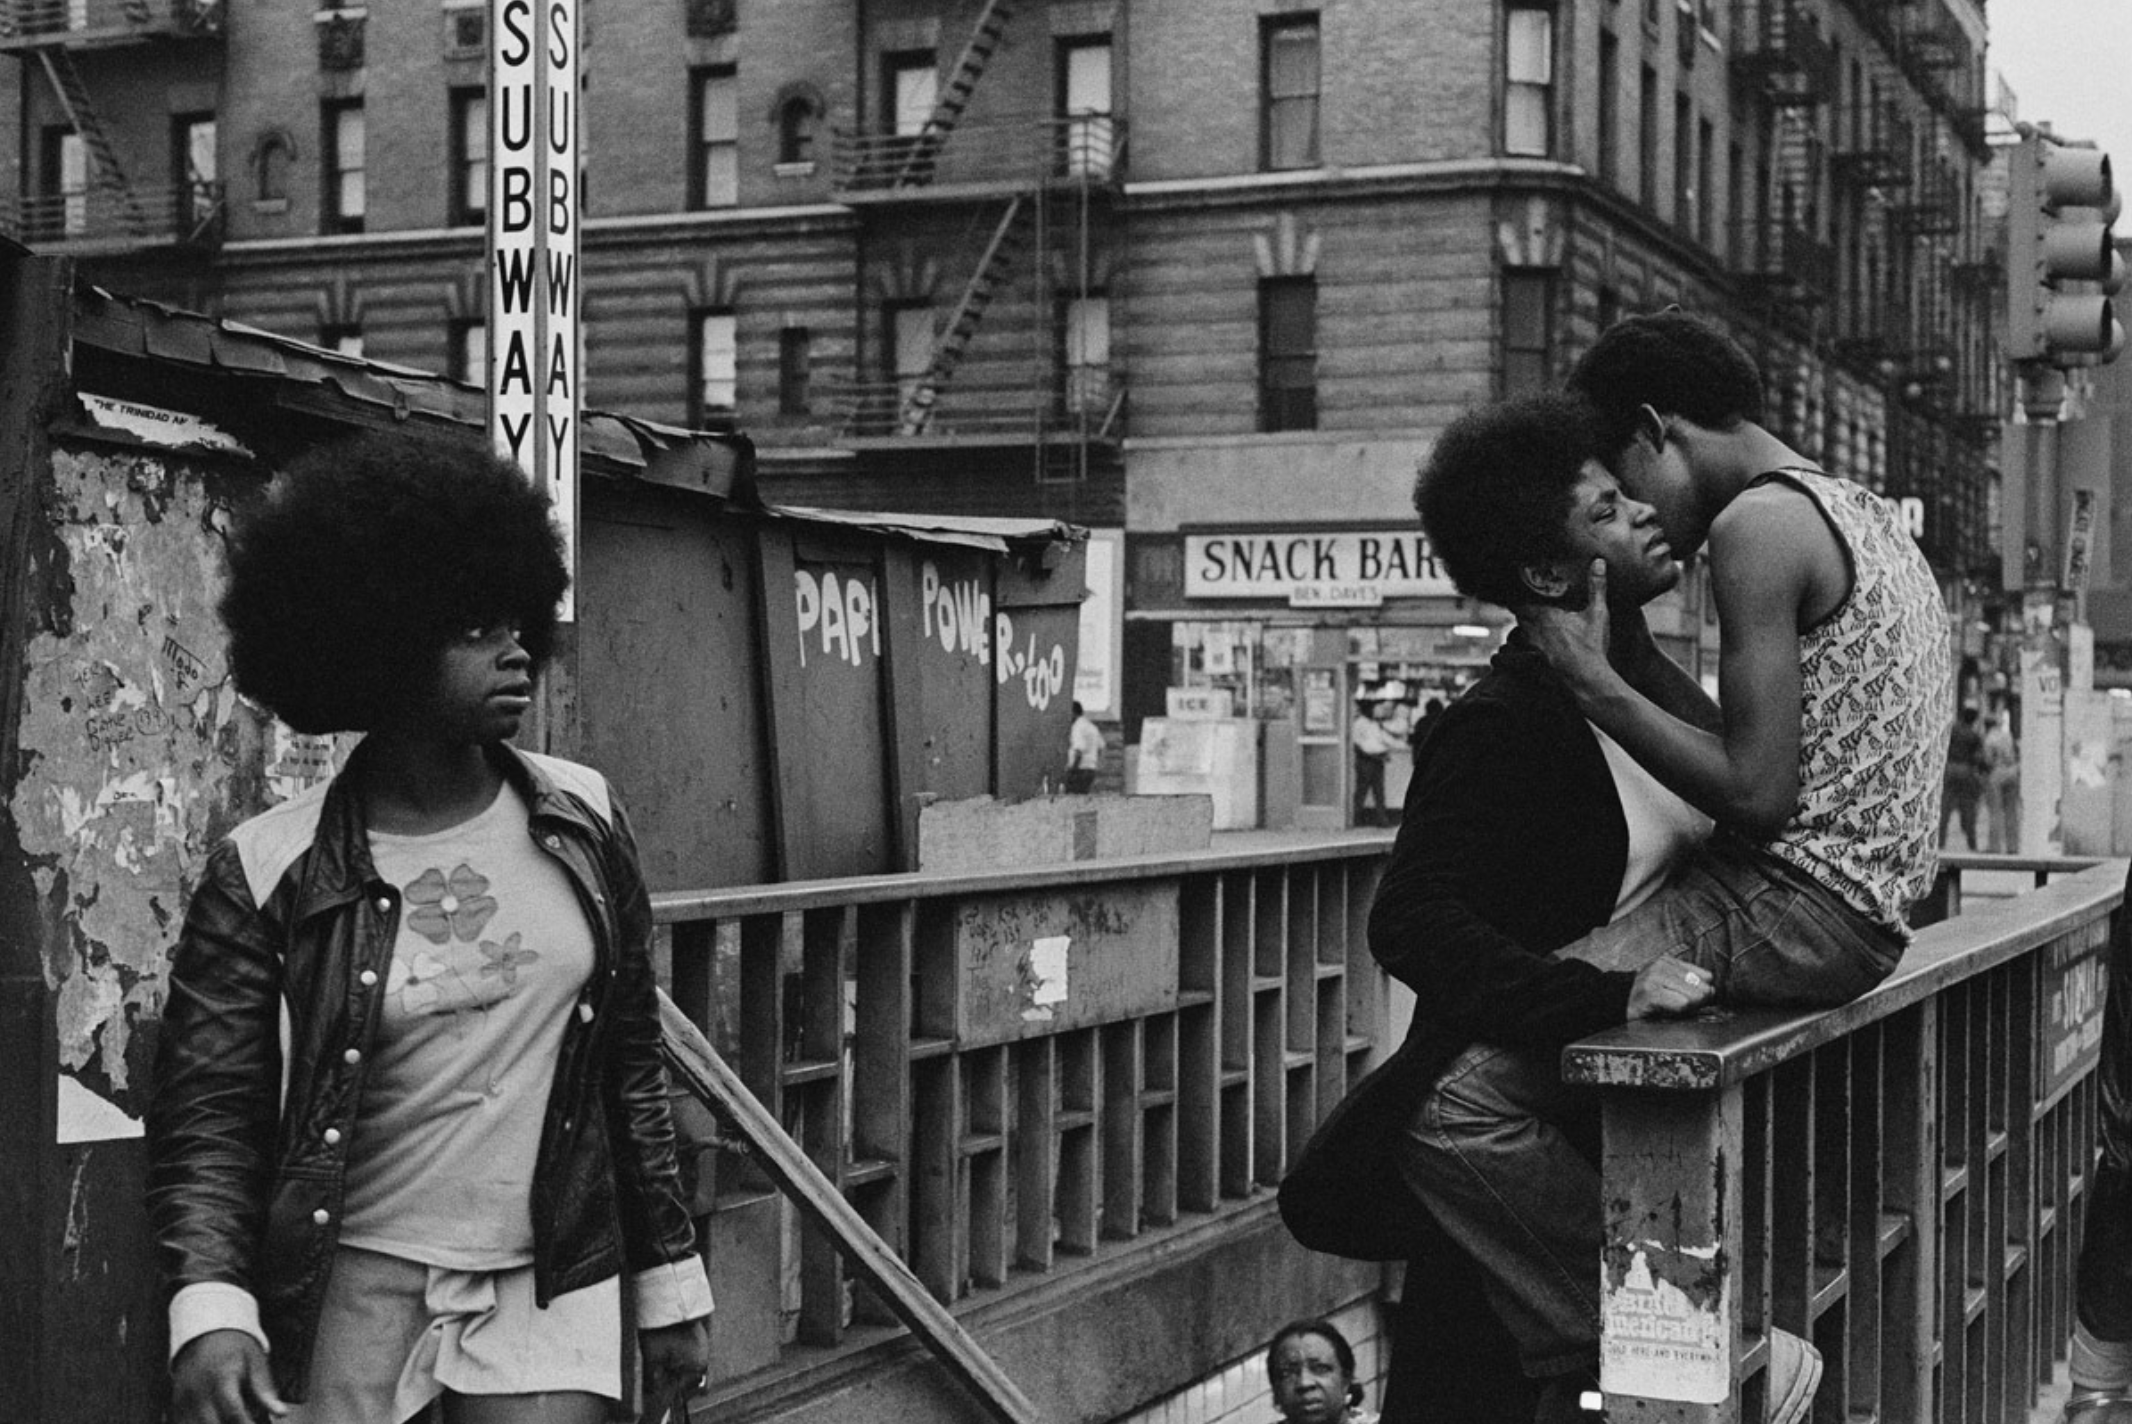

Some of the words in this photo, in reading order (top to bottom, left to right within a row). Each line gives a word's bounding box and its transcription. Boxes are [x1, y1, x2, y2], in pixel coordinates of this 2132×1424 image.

[497, 0, 535, 461] SUBWAY
[546, 3, 572, 480] SUBWAY
[94, 399, 115, 411] THE
[120, 405, 169, 422] TRINIDAD
[1202, 539, 1337, 581] SNACK
[1360, 538, 1438, 580] BAR
[1024, 633, 1064, 711] too
